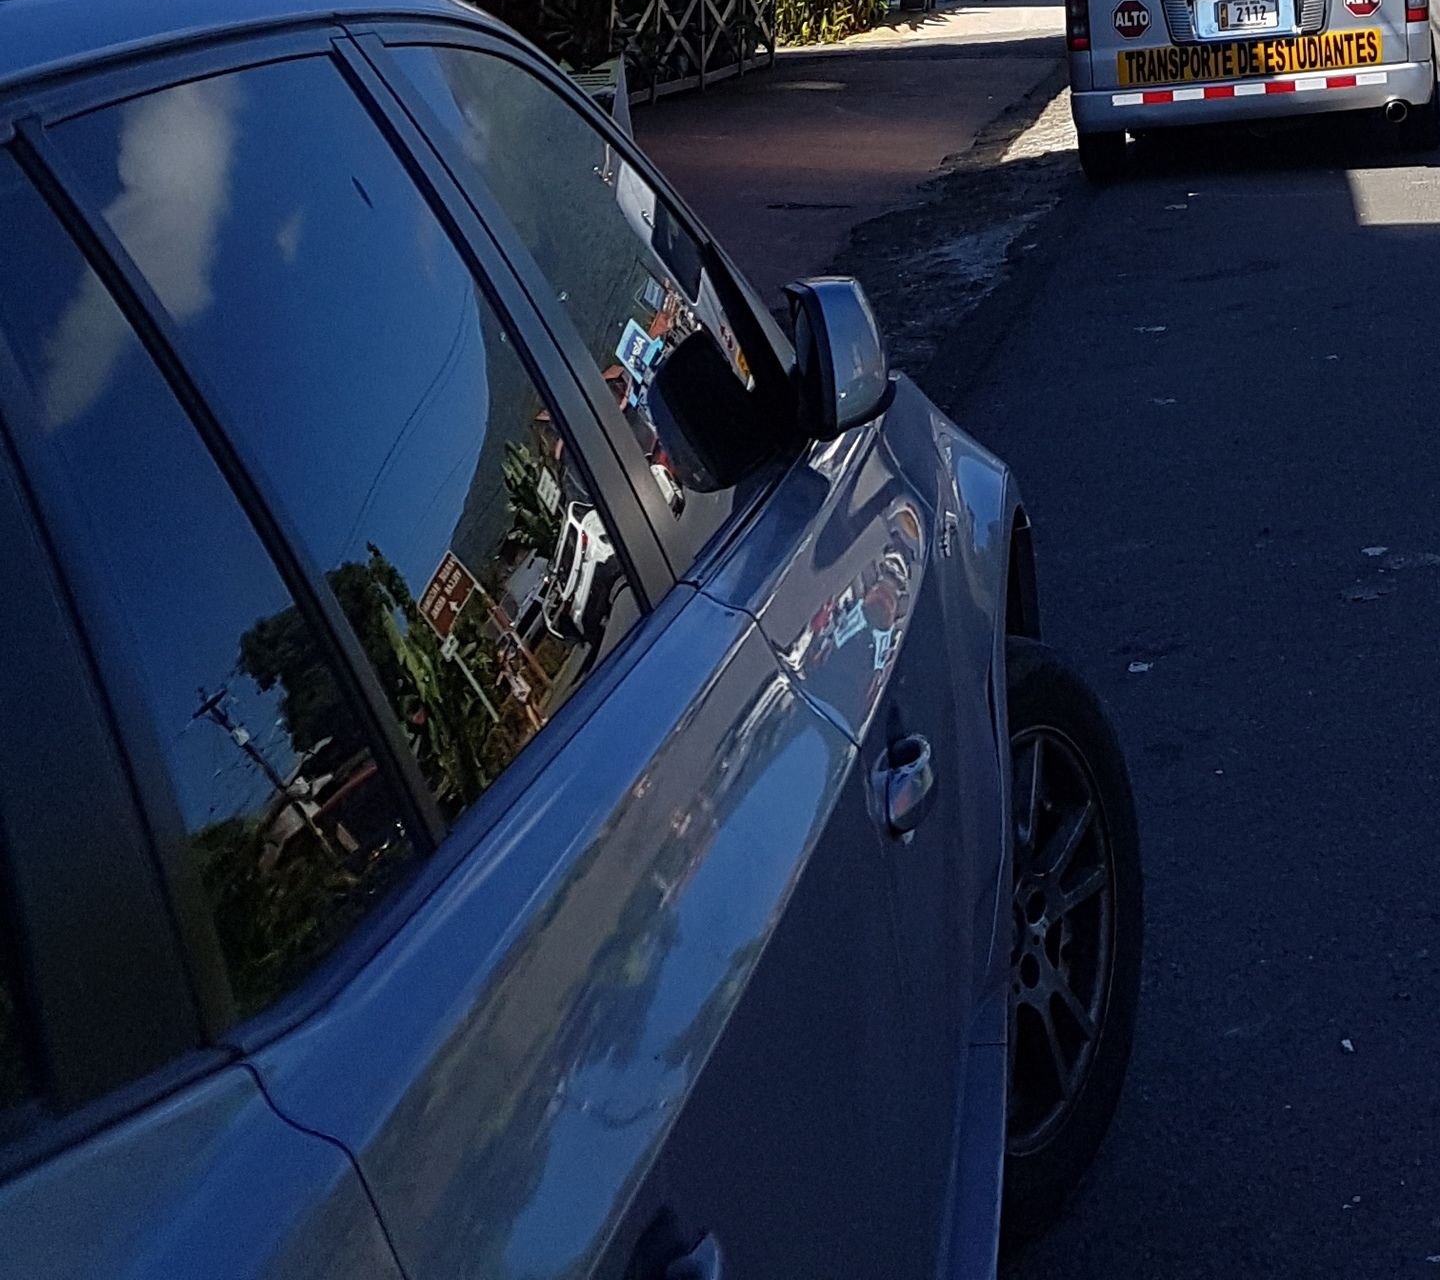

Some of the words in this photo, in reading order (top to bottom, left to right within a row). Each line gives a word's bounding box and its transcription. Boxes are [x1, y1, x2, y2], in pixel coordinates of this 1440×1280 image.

[1115, 10, 1149, 28] ALTO
[1236, 4, 1268, 23] 2112
[1124, 42, 1234, 85] TRANSPORTE
[1237, 40, 1262, 75] DE
[1263, 31, 1379, 72] ESTUDIANTES
